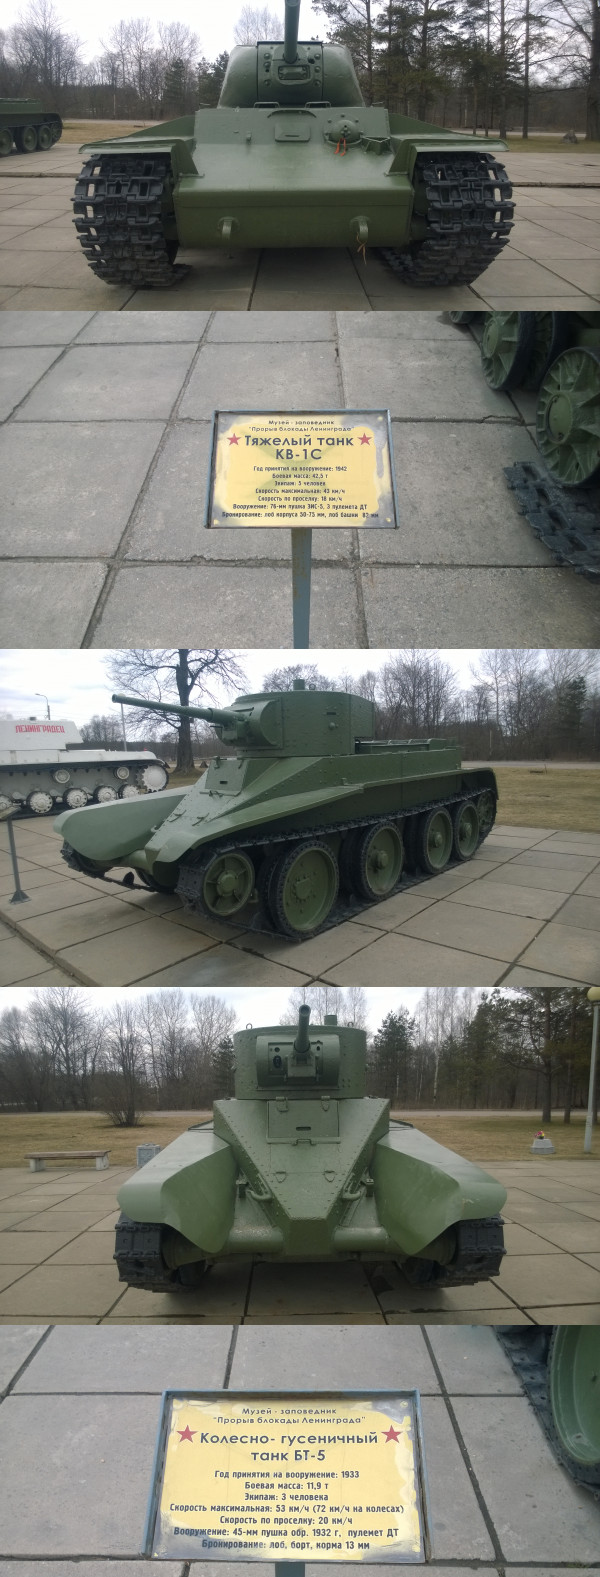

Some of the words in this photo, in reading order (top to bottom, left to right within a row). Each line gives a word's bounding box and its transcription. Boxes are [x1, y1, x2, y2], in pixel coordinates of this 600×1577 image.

[245, 435, 311, 446] Тяжелый
[317, 438, 353, 446] танк
[276, 449, 321, 460] КВ-1С
[16, 724, 65, 734] ЛЕНИНГРАДЕЦ
[201, 1433, 275, 1444] Колесно-
[281, 1432, 377, 1446] гусеничный
[251, 1452, 289, 1461] танк
[295, 1450, 325, 1461] БТ-5
[170, 1503, 207, 1512] Скорость
[289, 1505, 309, 1513] км/ч
[313, 1505, 326, 1513] (72
[329, 1505, 350, 1514] км/ч
[366, 1505, 404, 1513] колесах)
[202, 1540, 266, 1549] Бронирование:
[345, 1541, 354, 1549] 13
